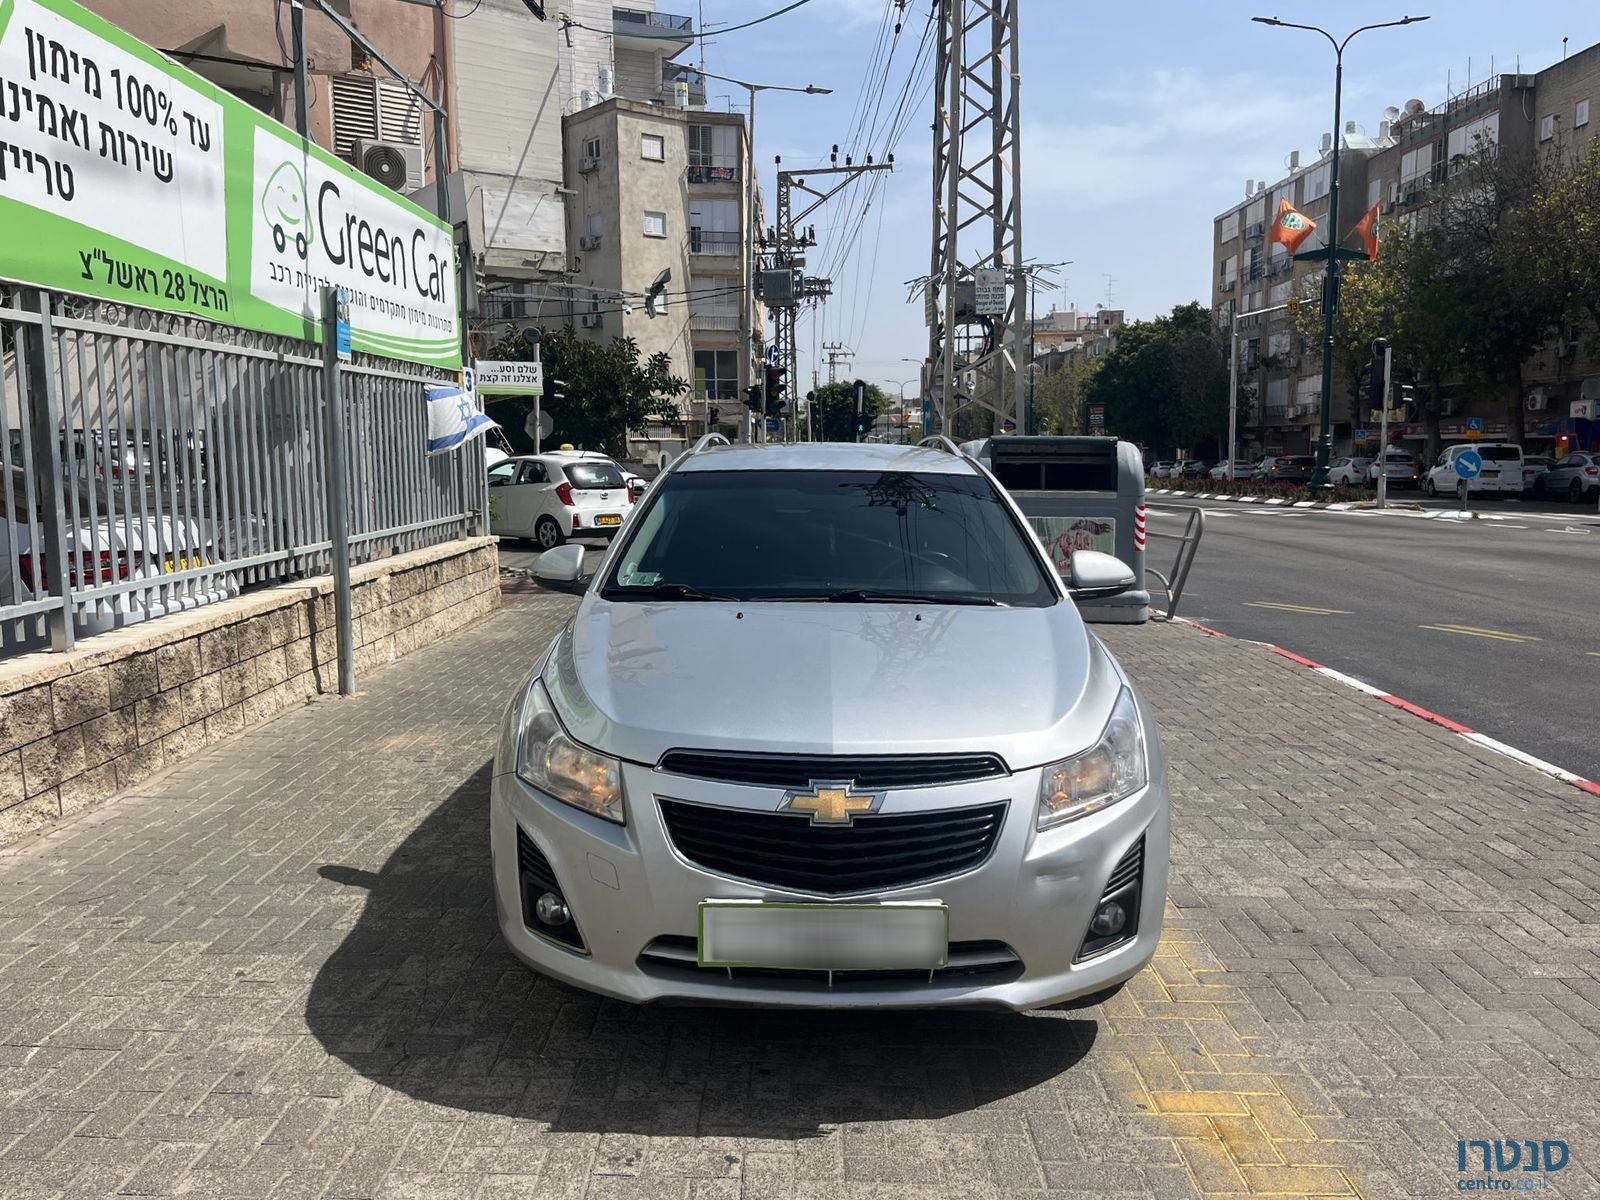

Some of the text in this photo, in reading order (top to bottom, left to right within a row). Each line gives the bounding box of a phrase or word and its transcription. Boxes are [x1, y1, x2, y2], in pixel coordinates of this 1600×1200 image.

[25, 26, 210, 152] עד 100% מימון
[98, 120, 174, 183] שירות
[318, 180, 448, 304] Green Car
[269, 261, 291, 285] רכב
[163, 269, 185, 302] 28
[189, 274, 228, 312] הרצל
[370, 295, 406, 320] מתקדמים
[408, 307, 426, 325] מימון
[428, 314, 452, 333] פתרונות
[480, 373, 498, 384] קצת
[490, 364, 537, 374] שלם וסע...
[501, 374, 511, 382] זה
[513, 374, 538, 383] אצלנו
